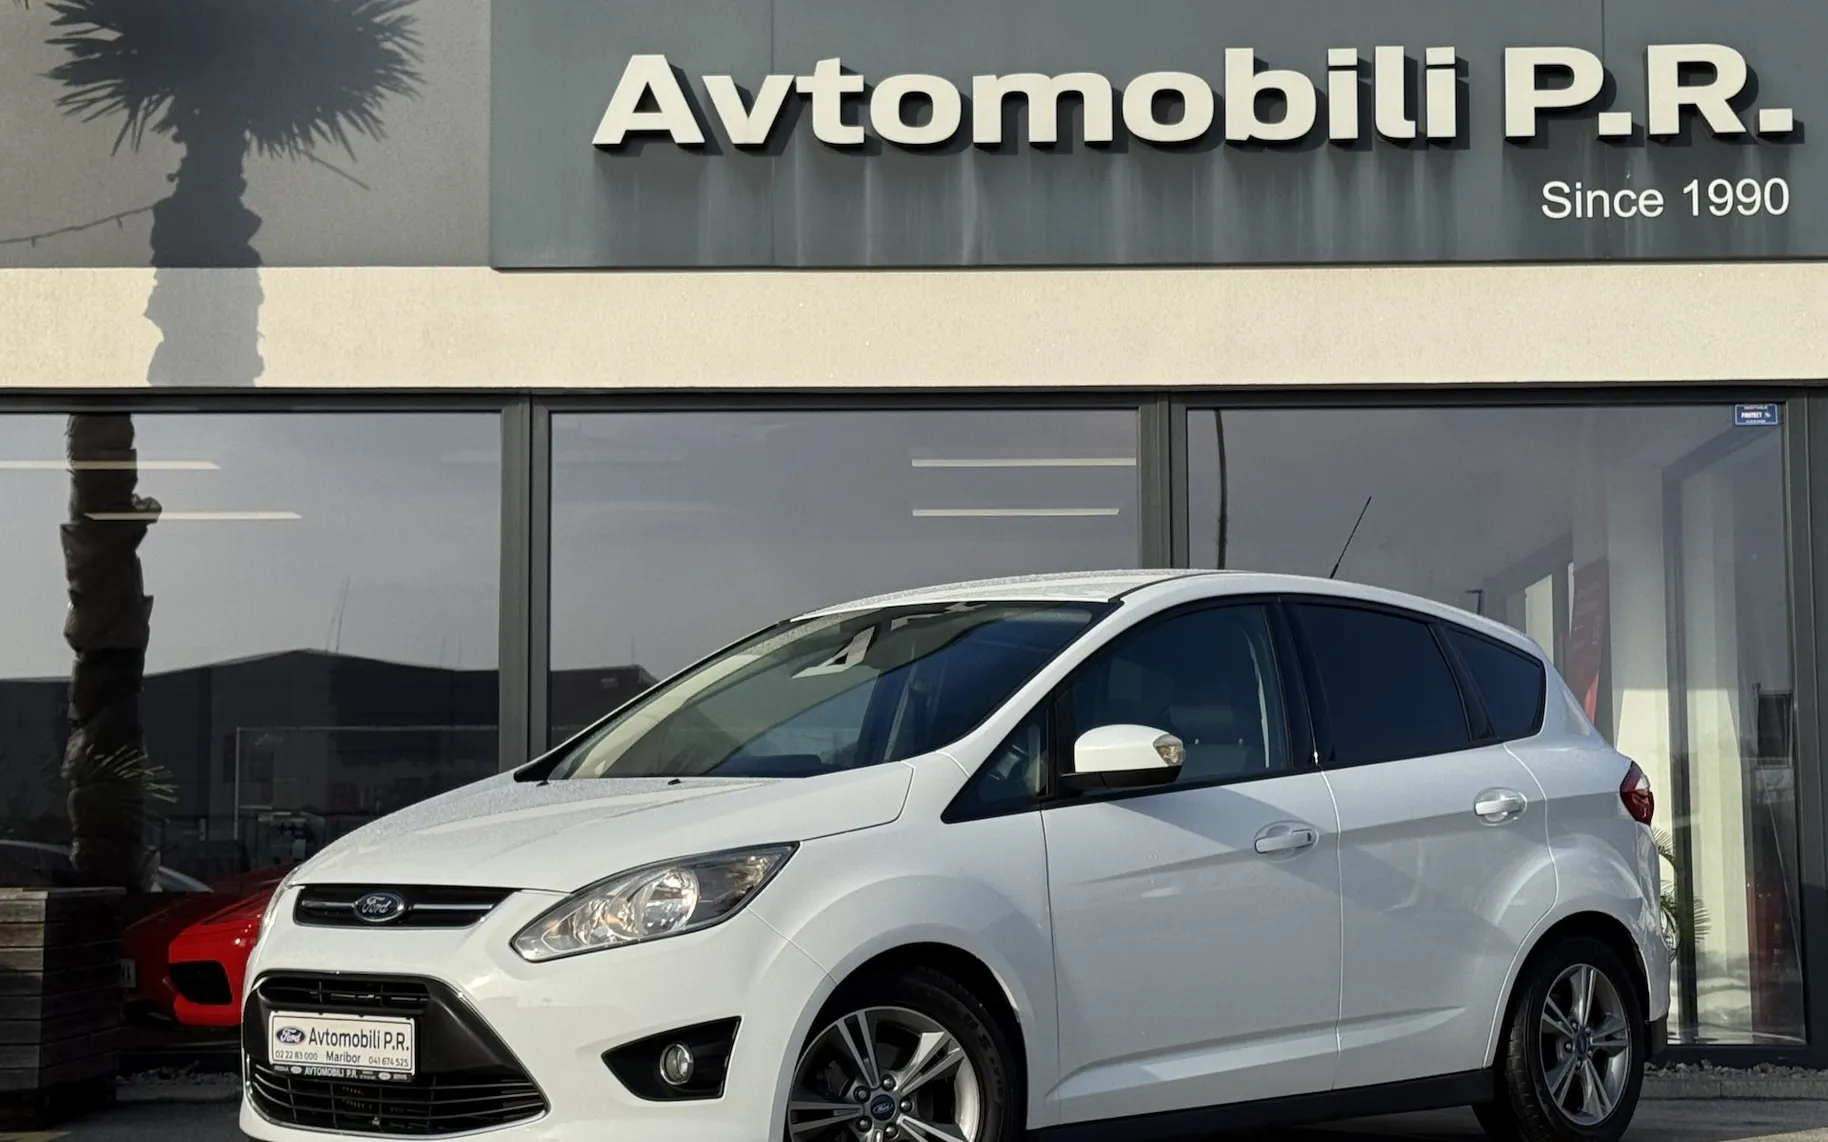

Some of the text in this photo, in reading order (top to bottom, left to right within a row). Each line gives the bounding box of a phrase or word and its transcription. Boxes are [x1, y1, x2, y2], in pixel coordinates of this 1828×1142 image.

[592, 43, 1793, 146] Avtomobili P.R.
[1541, 177, 1790, 219] Since 1990
[361, 896, 392, 913] Ford
[279, 1026, 410, 1051] Ford Avtomobili P.R.
[275, 1050, 284, 1059] 02
[285, 1050, 293, 1059] 22
[304, 1051, 318, 1061] 000
[326, 1050, 361, 1063] Maribor
[368, 1056, 380, 1065] 041
[304, 1066, 344, 1078] AVTOMOBILI
